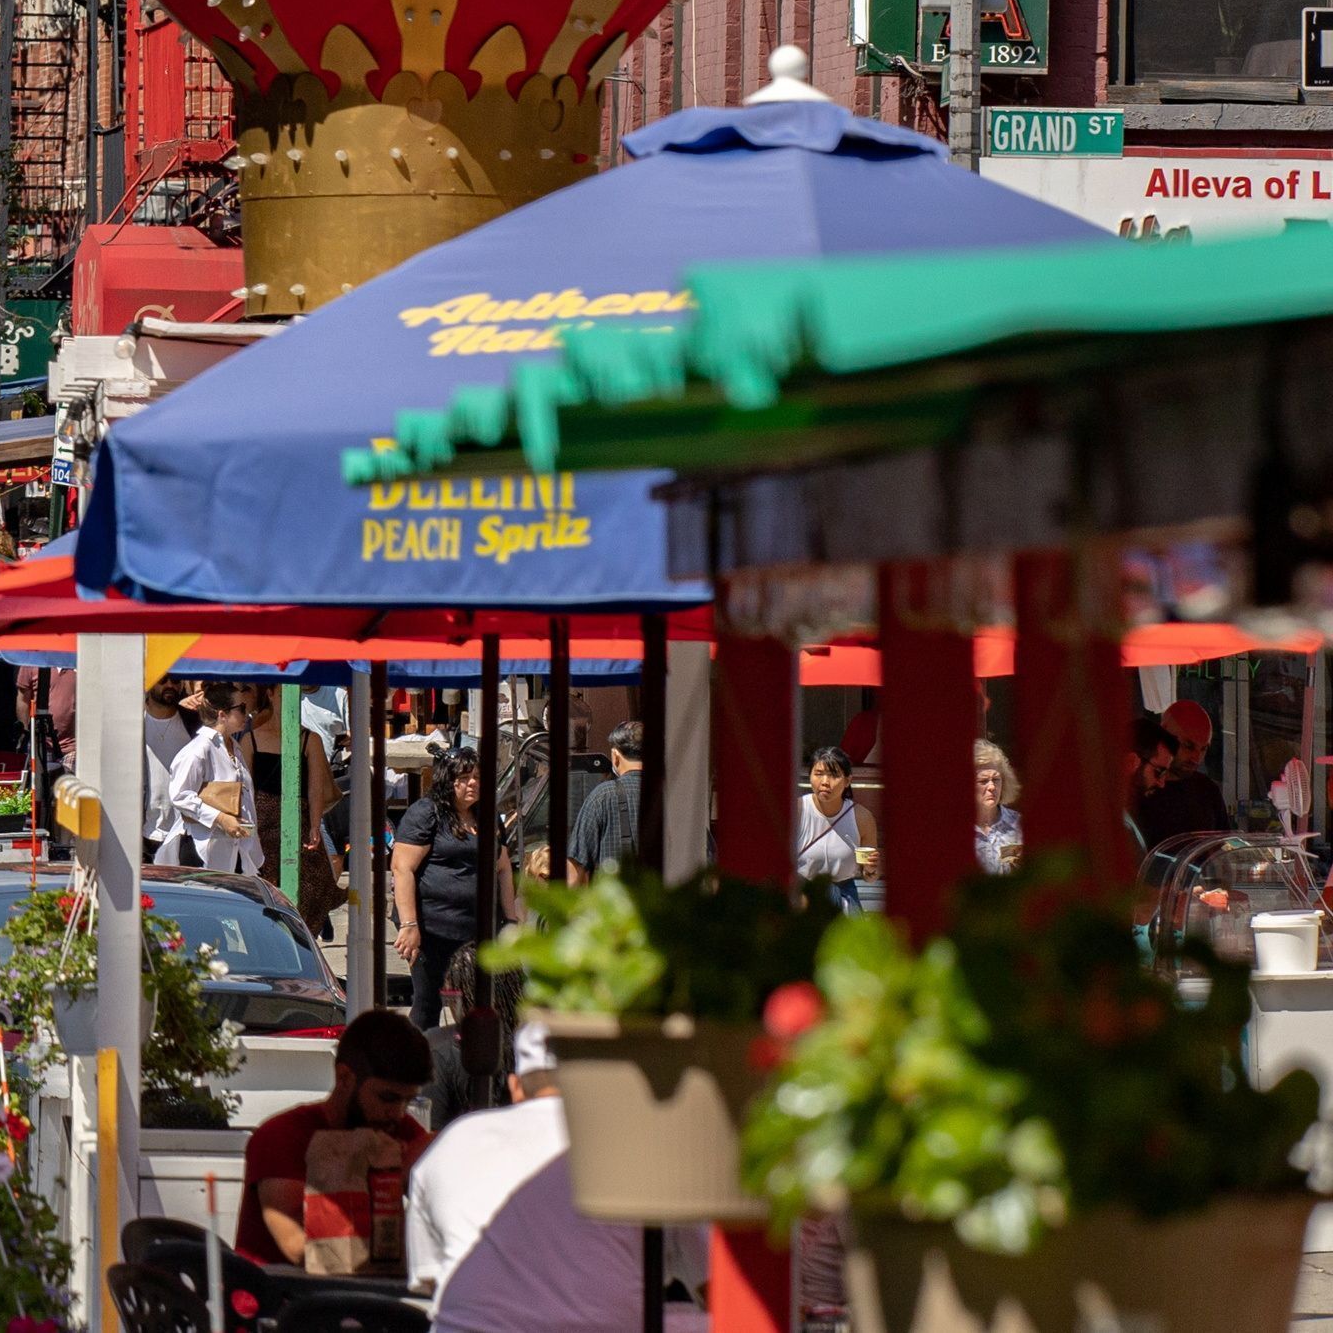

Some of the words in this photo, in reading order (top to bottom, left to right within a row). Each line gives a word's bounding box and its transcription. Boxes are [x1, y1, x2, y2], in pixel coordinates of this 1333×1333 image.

[994, 115, 1077, 152] GRAND
[1088, 117, 1116, 135] ST
[1145, 168, 1252, 198] Alleva
[1264, 169, 1300, 199] of
[362, 518, 461, 561] PEACH
[475, 511, 591, 564] Spritz
